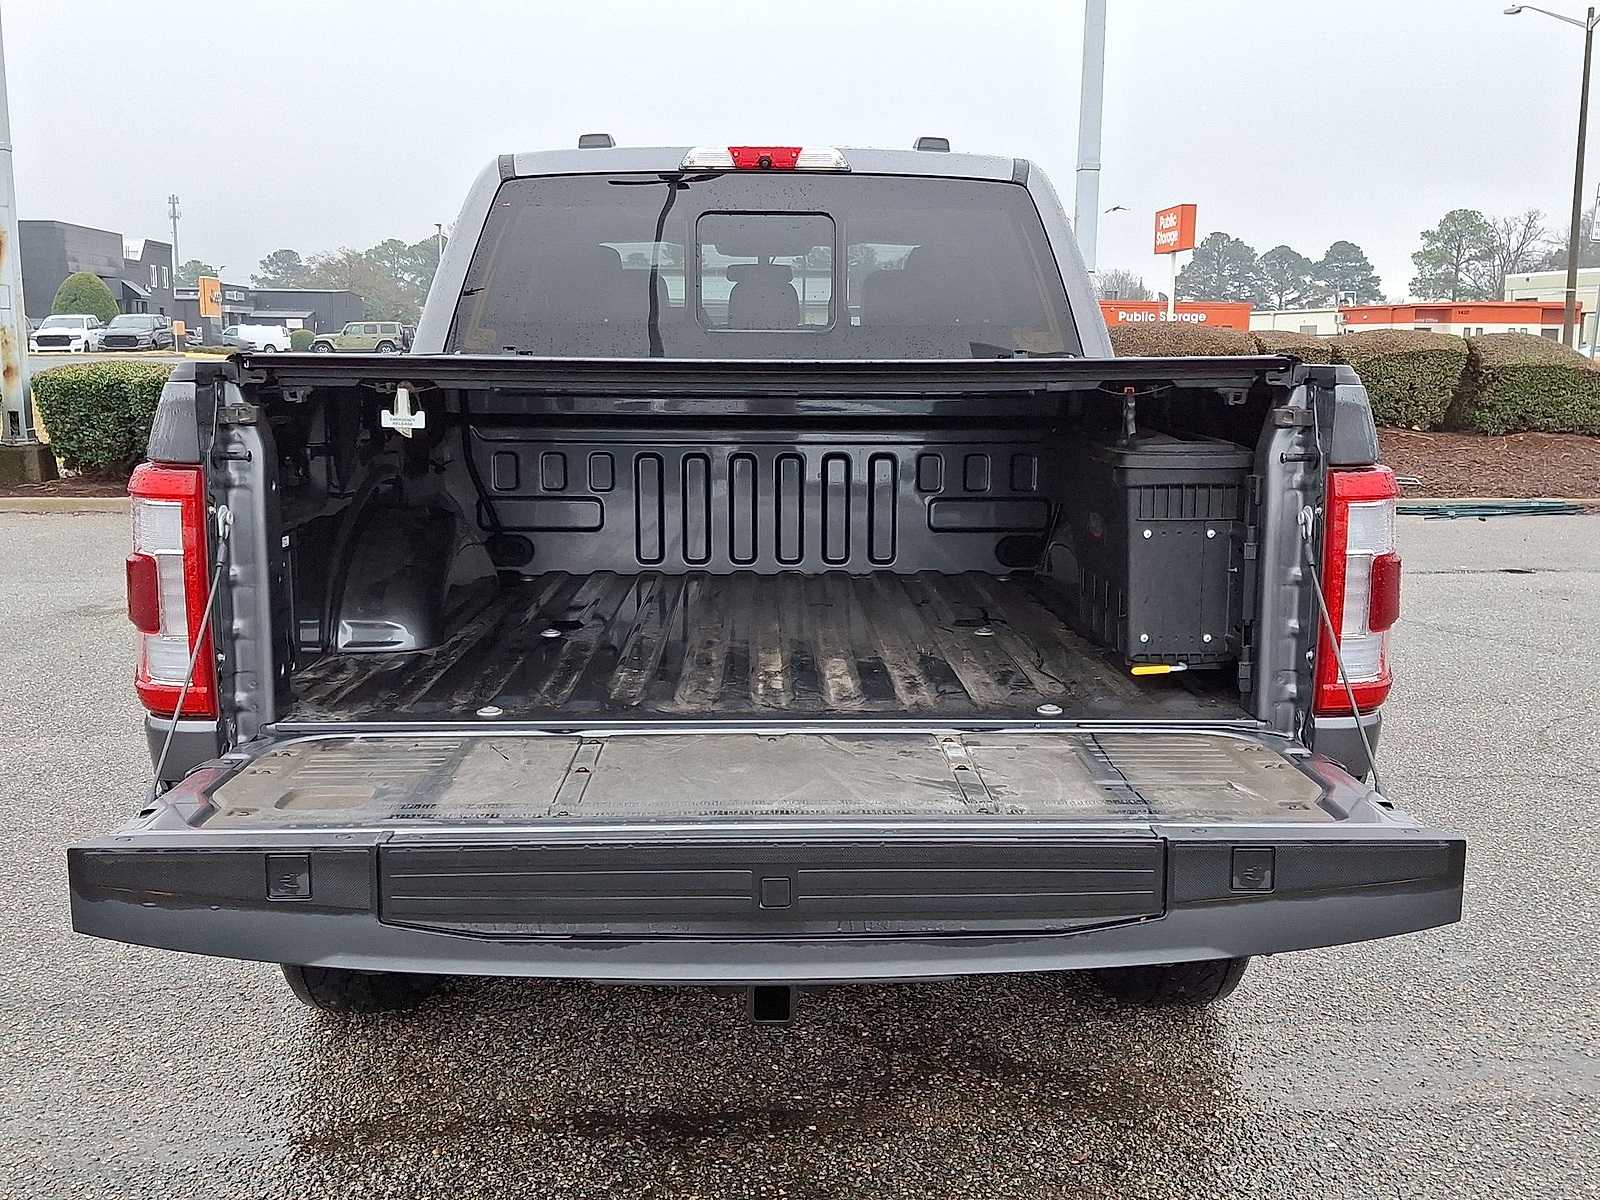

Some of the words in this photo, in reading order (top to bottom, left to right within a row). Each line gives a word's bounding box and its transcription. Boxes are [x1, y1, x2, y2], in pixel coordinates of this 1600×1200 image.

[1159, 212, 1178, 230] Public
[1156, 231, 1179, 246] Storage
[1118, 311, 1155, 322] Public
